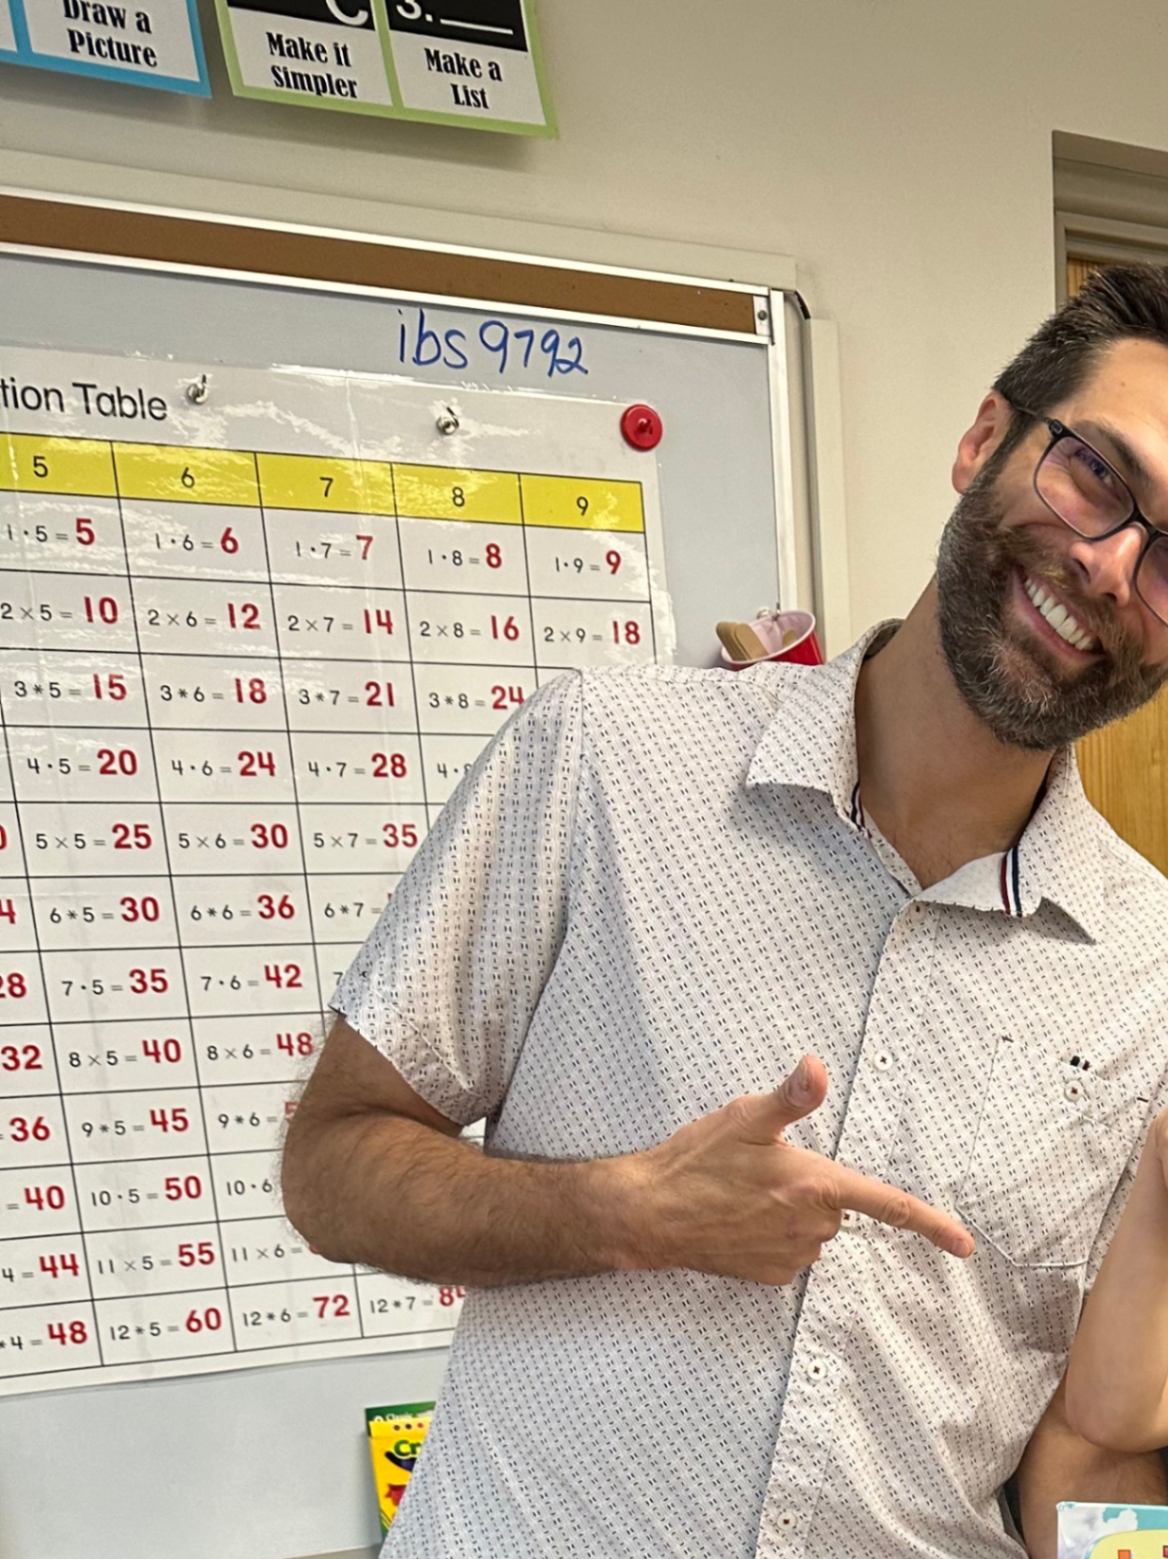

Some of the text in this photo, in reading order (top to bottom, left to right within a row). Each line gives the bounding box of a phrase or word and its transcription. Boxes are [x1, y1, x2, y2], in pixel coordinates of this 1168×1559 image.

[63, 0, 152, 34] Draw a
[67, 29, 158, 68] Picture
[266, 32, 352, 67] Make it
[424, 48, 503, 82] Make a
[270, 65, 358, 99] Simpler
[450, 83, 489, 110] List
[478, 321, 589, 377] 9792
[72, 382, 168, 422] Table
[33, 456, 48, 478] 5
[181, 467, 195, 488] 6
[320, 477, 333, 497] 7
[452, 487, 465, 507] 8
[576, 496, 589, 517] 9
[36, 517, 96, 545] 5 5
[183, 527, 240, 555] 6 6
[321, 534, 374, 561] 7 7
[452, 543, 503, 569] 8 8
[573, 549, 622, 574] 9 9
[0, 596, 119, 625] 2 5 10
[148, 603, 259, 630] 2 6 12
[288, 610, 394, 633] 2 7 14
[420, 616, 520, 641] 2 8 16
[543, 620, 641, 645] 2 9 18
[14, 673, 128, 702] 3 5 15
[160, 678, 268, 705] 3 6 18
[299, 680, 395, 707] 3 7 21
[429, 692, 440, 708] 3
[458, 693, 469, 709] 8
[27, 747, 138, 776] 4 5 20
[172, 750, 277, 778] 4 6 24
[308, 751, 408, 779] 4 7 28
[111, 822, 153, 850] 25
[251, 823, 289, 849] 30
[383, 823, 418, 848] 35
[50, 895, 161, 924] 6 5 30
[191, 894, 295, 921] 6 6 36
[129, 967, 169, 994] 35
[264, 962, 302, 989] 42
[1, 1044, 42, 1072] 32
[69, 1038, 182, 1068] 8 5 40
[207, 1032, 314, 1061] 8 6 48
[10, 1116, 51, 1143] 36
[150, 1107, 190, 1133] 45
[24, 1184, 65, 1211] 40
[91, 1175, 203, 1206] 10 5 50
[227, 1179, 272, 1196] 10 6
[98, 1242, 215, 1274] 11 5 55
[232, 1244, 285, 1262] 11 6
[2, 1253, 80, 1282] 4 44
[243, 1293, 351, 1326] 12 6 72
[370, 1296, 416, 1313] 12 7
[10, 1319, 89, 1350] 4 48
[110, 1307, 223, 1340] 12 5 60
